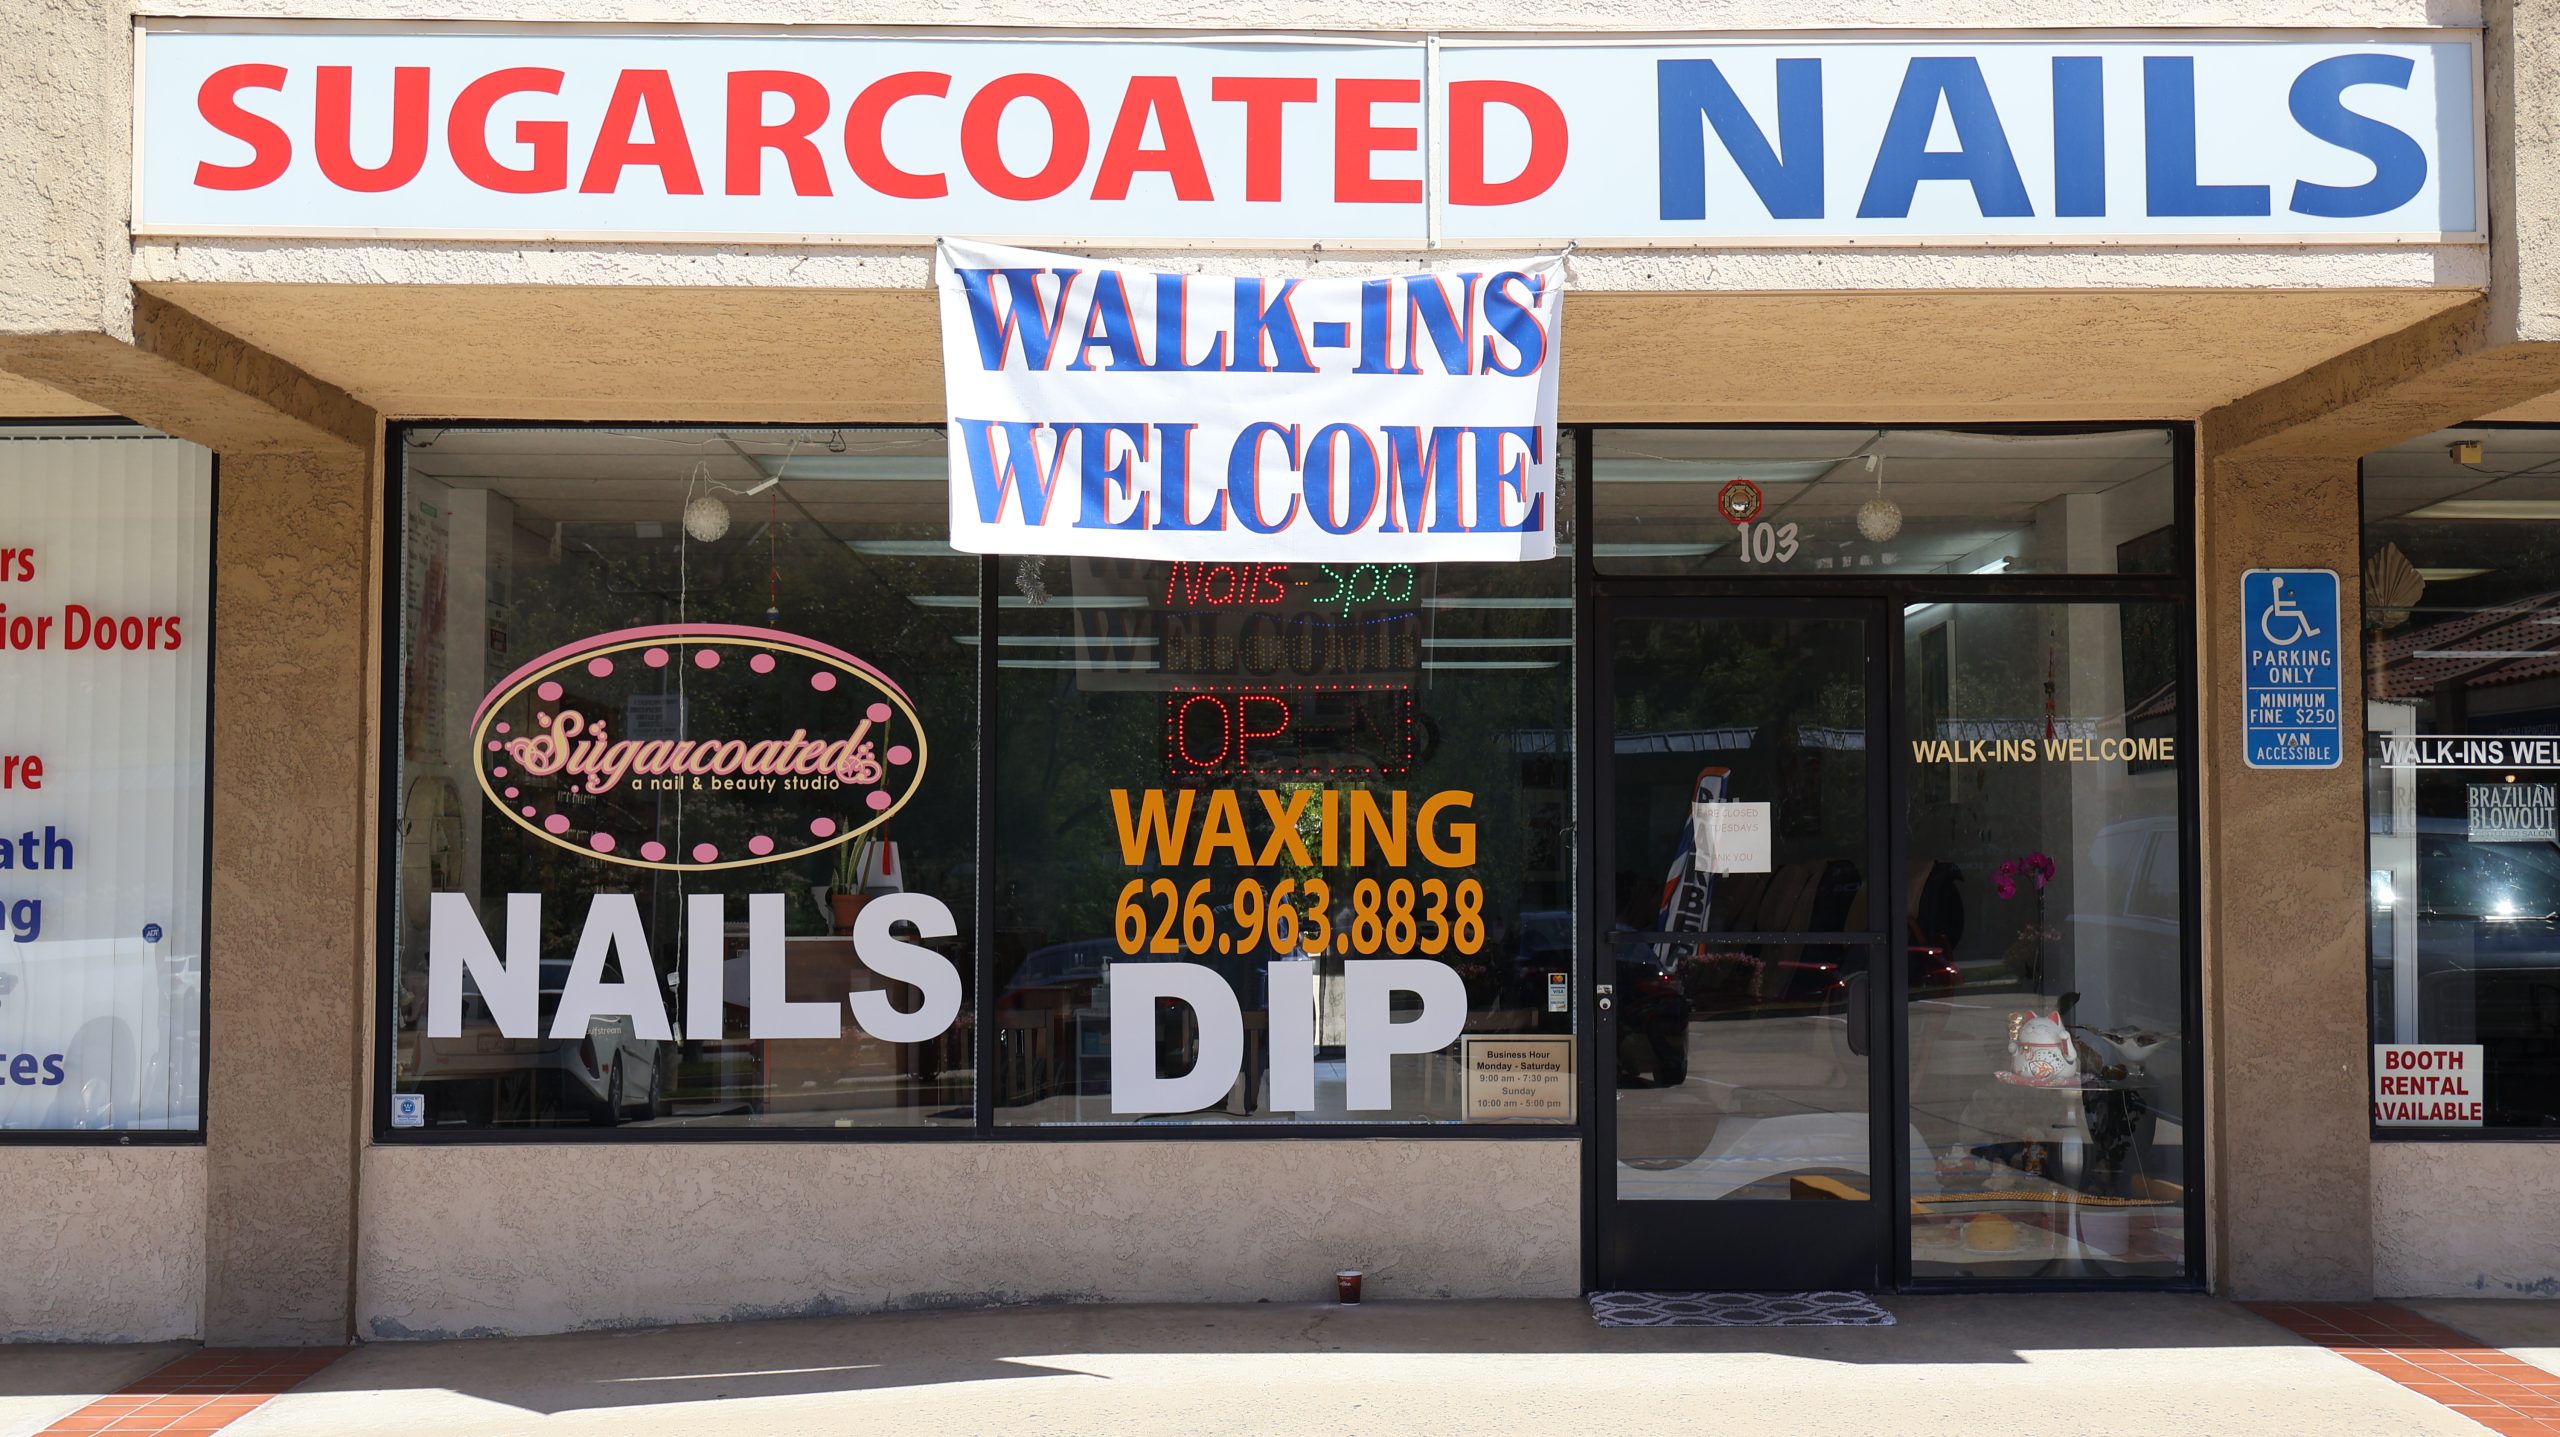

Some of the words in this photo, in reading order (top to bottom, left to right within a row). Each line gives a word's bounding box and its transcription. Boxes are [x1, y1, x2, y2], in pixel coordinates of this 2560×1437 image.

[194, 63, 1569, 206] SUGARCOATED
[1657, 53, 2428, 220] NAILS
[955, 267, 1548, 378] WALK-INS
[955, 417, 1545, 536] WELCOME
[1737, 522, 1799, 563] 103
[1166, 561, 1288, 604] Nails
[1313, 563, 1413, 618] Spa
[64, 604, 182, 650] Doors
[2252, 650, 2331, 666] PARKING
[2269, 668, 2314, 683] ONLY
[2260, 694, 2325, 708] MINIMUM
[2250, 709, 2283, 723] FINE
[2296, 708, 2335, 725] $250
[2277, 733, 2310, 746] VAN
[505, 709, 883, 794] Sugarcoated
[1912, 739, 2037, 763] WALK-INS
[2044, 738, 2175, 761] WELCOME
[2257, 746, 2331, 760] ACCESSIBLE
[2380, 741, 2504, 764] WALK-INS
[632, 779, 642, 790] a
[650, 775, 684, 791] nail
[693, 776, 703, 790] &
[711, 775, 776, 793] beauty
[784, 775, 840, 791] studio
[2469, 786, 2556, 808] BRAZILIAN
[1110, 788, 1477, 868] WAXING
[2470, 808, 2556, 829] BLOWOUT
[2522, 830, 2552, 838] SALON
[1115, 878, 1485, 956] 626.963.8838
[427, 891, 963, 1043] NAILS
[1110, 959, 1467, 1114] DIP
[1487, 1050, 1527, 1059] Business
[1529, 1050, 1550, 1059] Hour
[2386, 1051, 2463, 1070] BOOTH
[1477, 1062, 1512, 1072] Monday
[1520, 1062, 1561, 1072] Saturday
[1523, 1074, 1542, 1082] 7:30
[1544, 1076, 1559, 1084] pm
[2381, 1076, 2469, 1095] RENTAL
[1502, 1087, 1536, 1097] Sunday
[1478, 1099, 1501, 1108] 10:00
[1525, 1099, 1545, 1108] 5:00
[1547, 1101, 1561, 1109] pm
[2375, 1102, 2482, 1120] AVAILABLE
